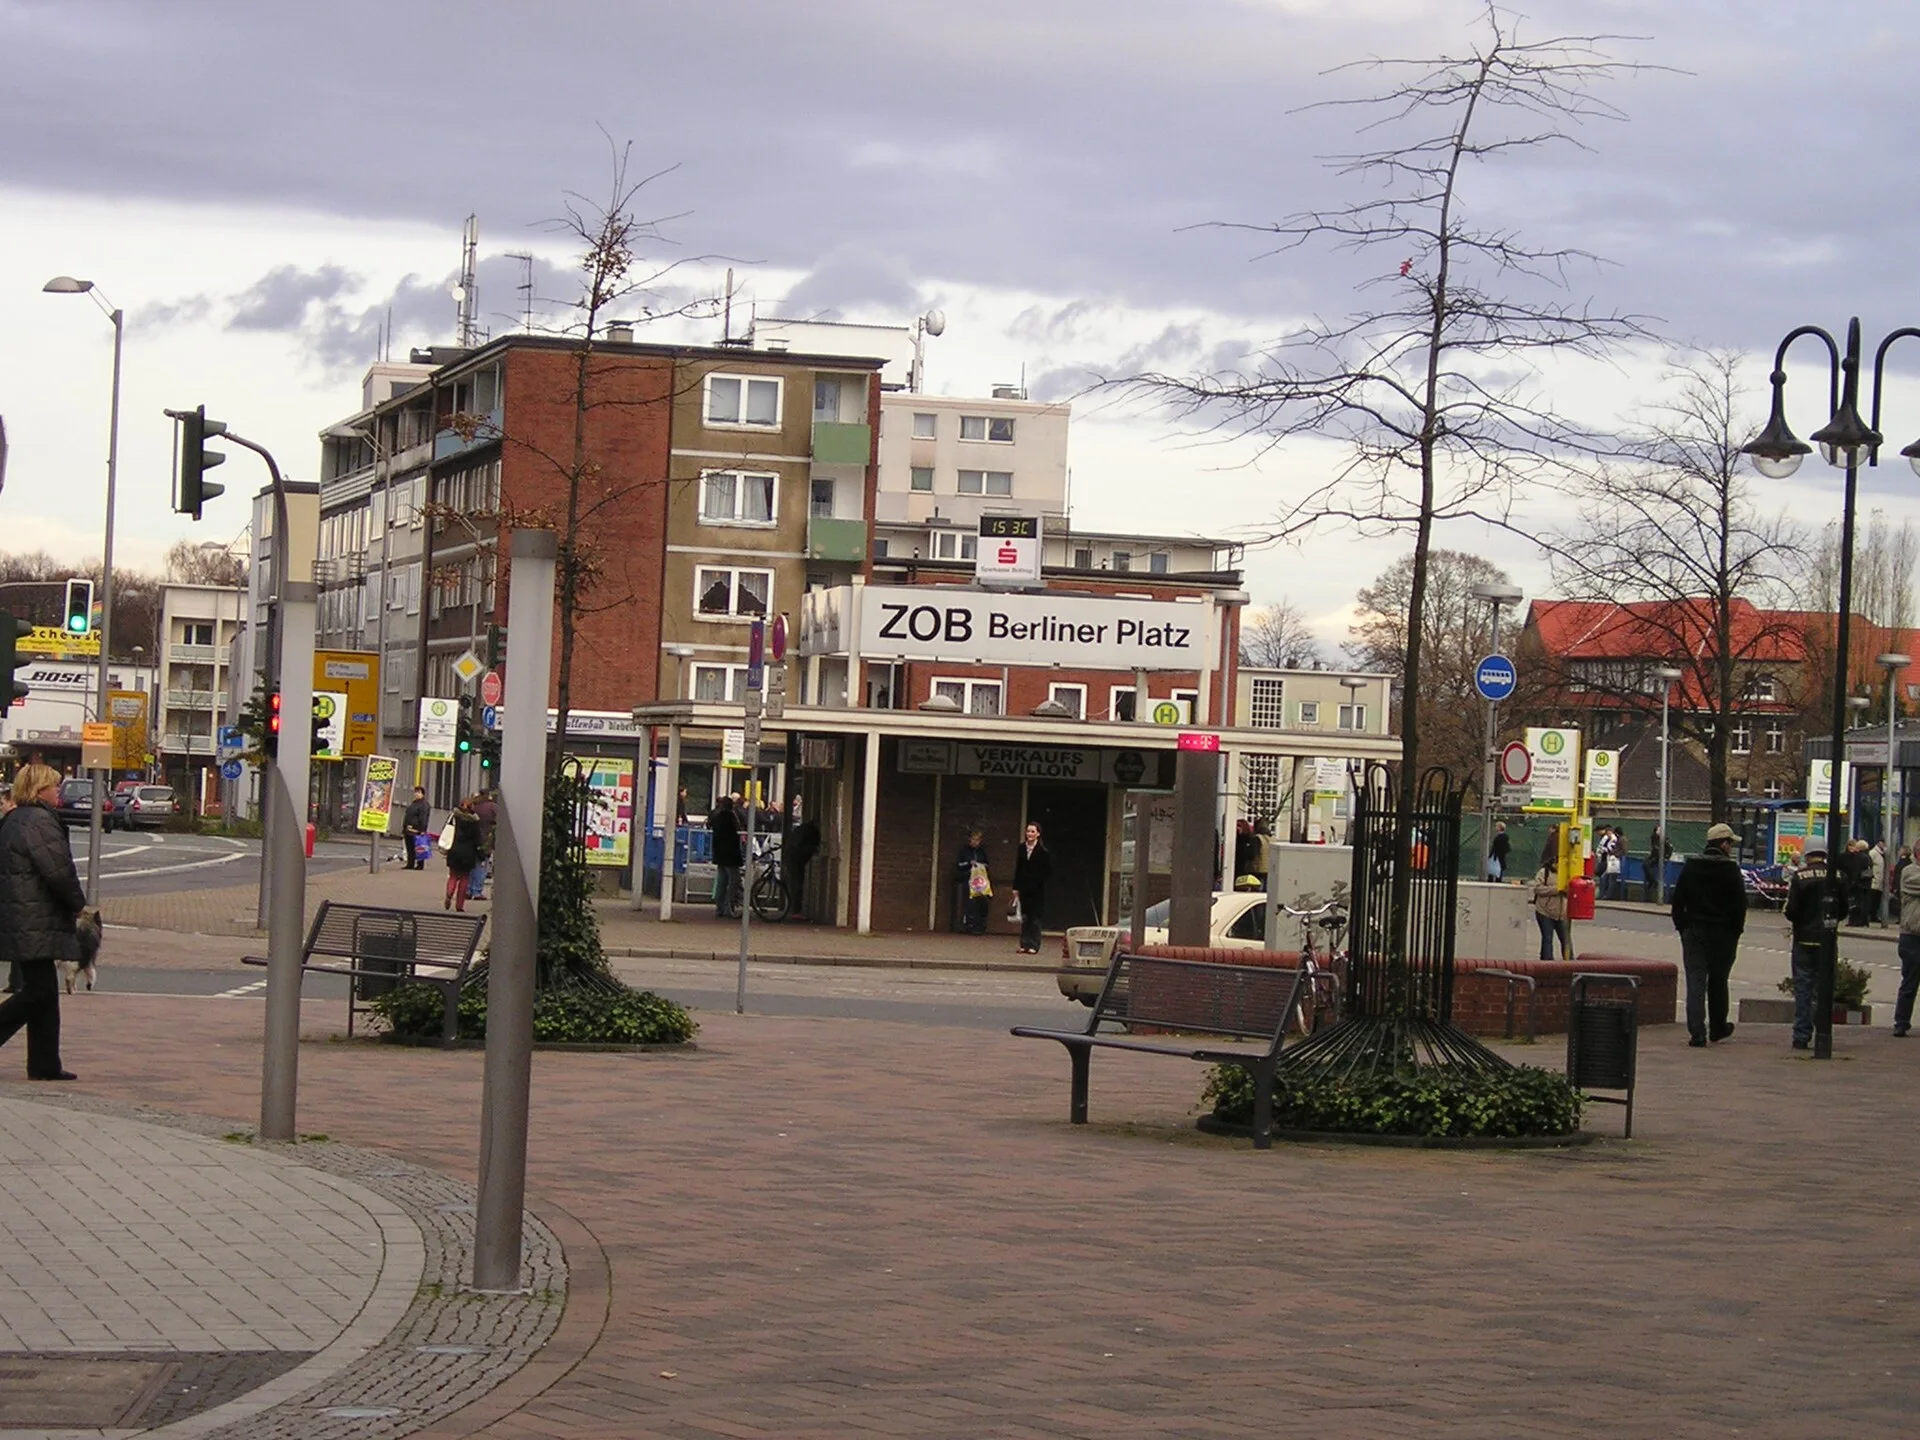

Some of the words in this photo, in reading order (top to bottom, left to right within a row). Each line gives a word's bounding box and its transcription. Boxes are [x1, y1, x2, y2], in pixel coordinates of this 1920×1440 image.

[879, 603, 973, 643] ZOB
[989, 612, 1108, 644] Berliner
[1116, 619, 1191, 648] Platz
[31, 671, 94, 684] BOSE
[975, 748, 1084, 765] VERKAUFS
[978, 762, 1078, 778] PAVILLON
